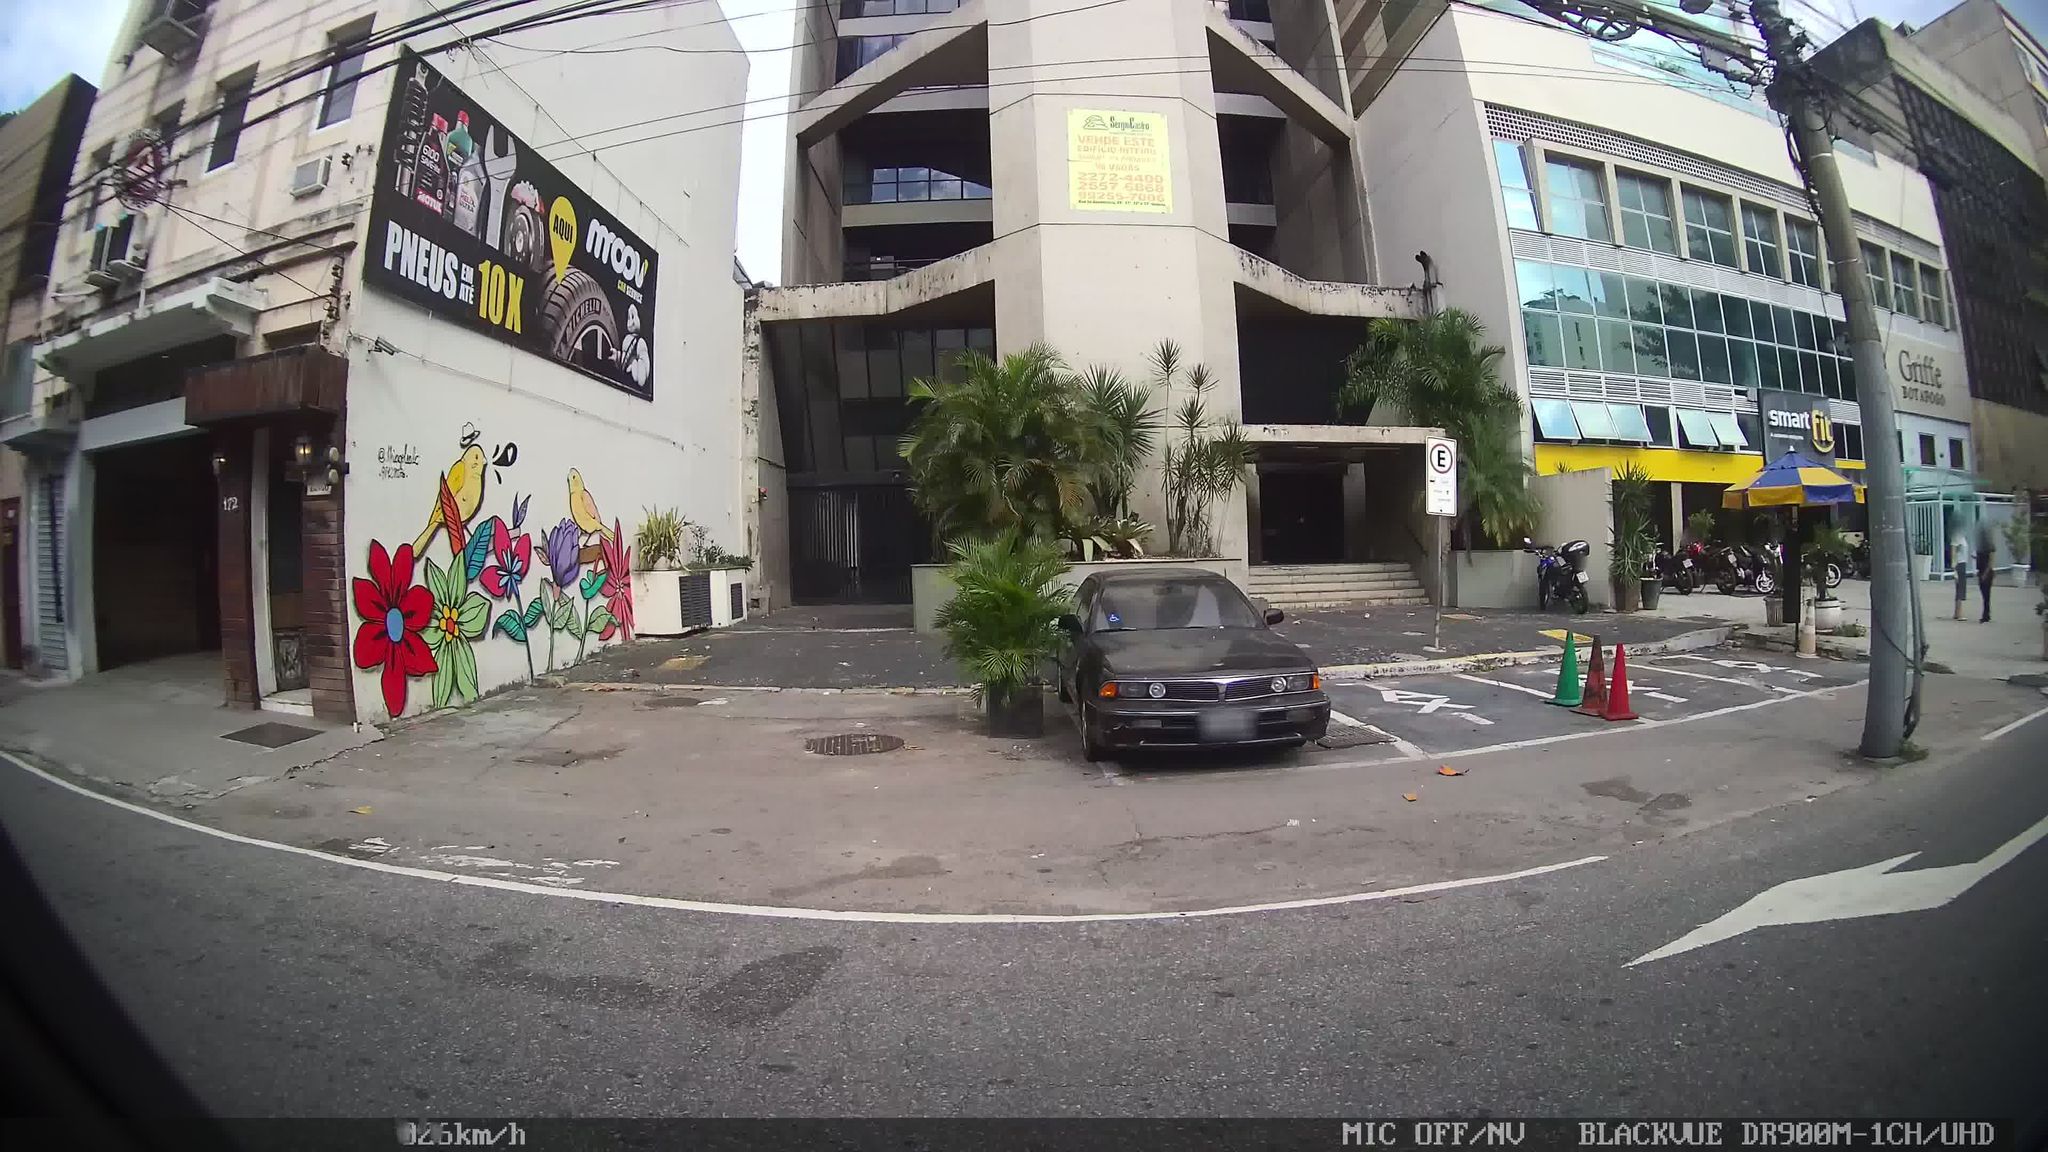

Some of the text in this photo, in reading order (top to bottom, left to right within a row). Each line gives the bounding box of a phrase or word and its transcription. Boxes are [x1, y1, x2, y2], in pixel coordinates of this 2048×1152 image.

[1078, 135, 1155, 147] VENDE ESTE
[553, 214, 573, 244] AQUI
[384, 219, 459, 299] PNEUS
[1898, 350, 1942, 389] Griffe
[1768, 410, 1834, 442] smart fit
[1437, 449, 1446, 468] E
